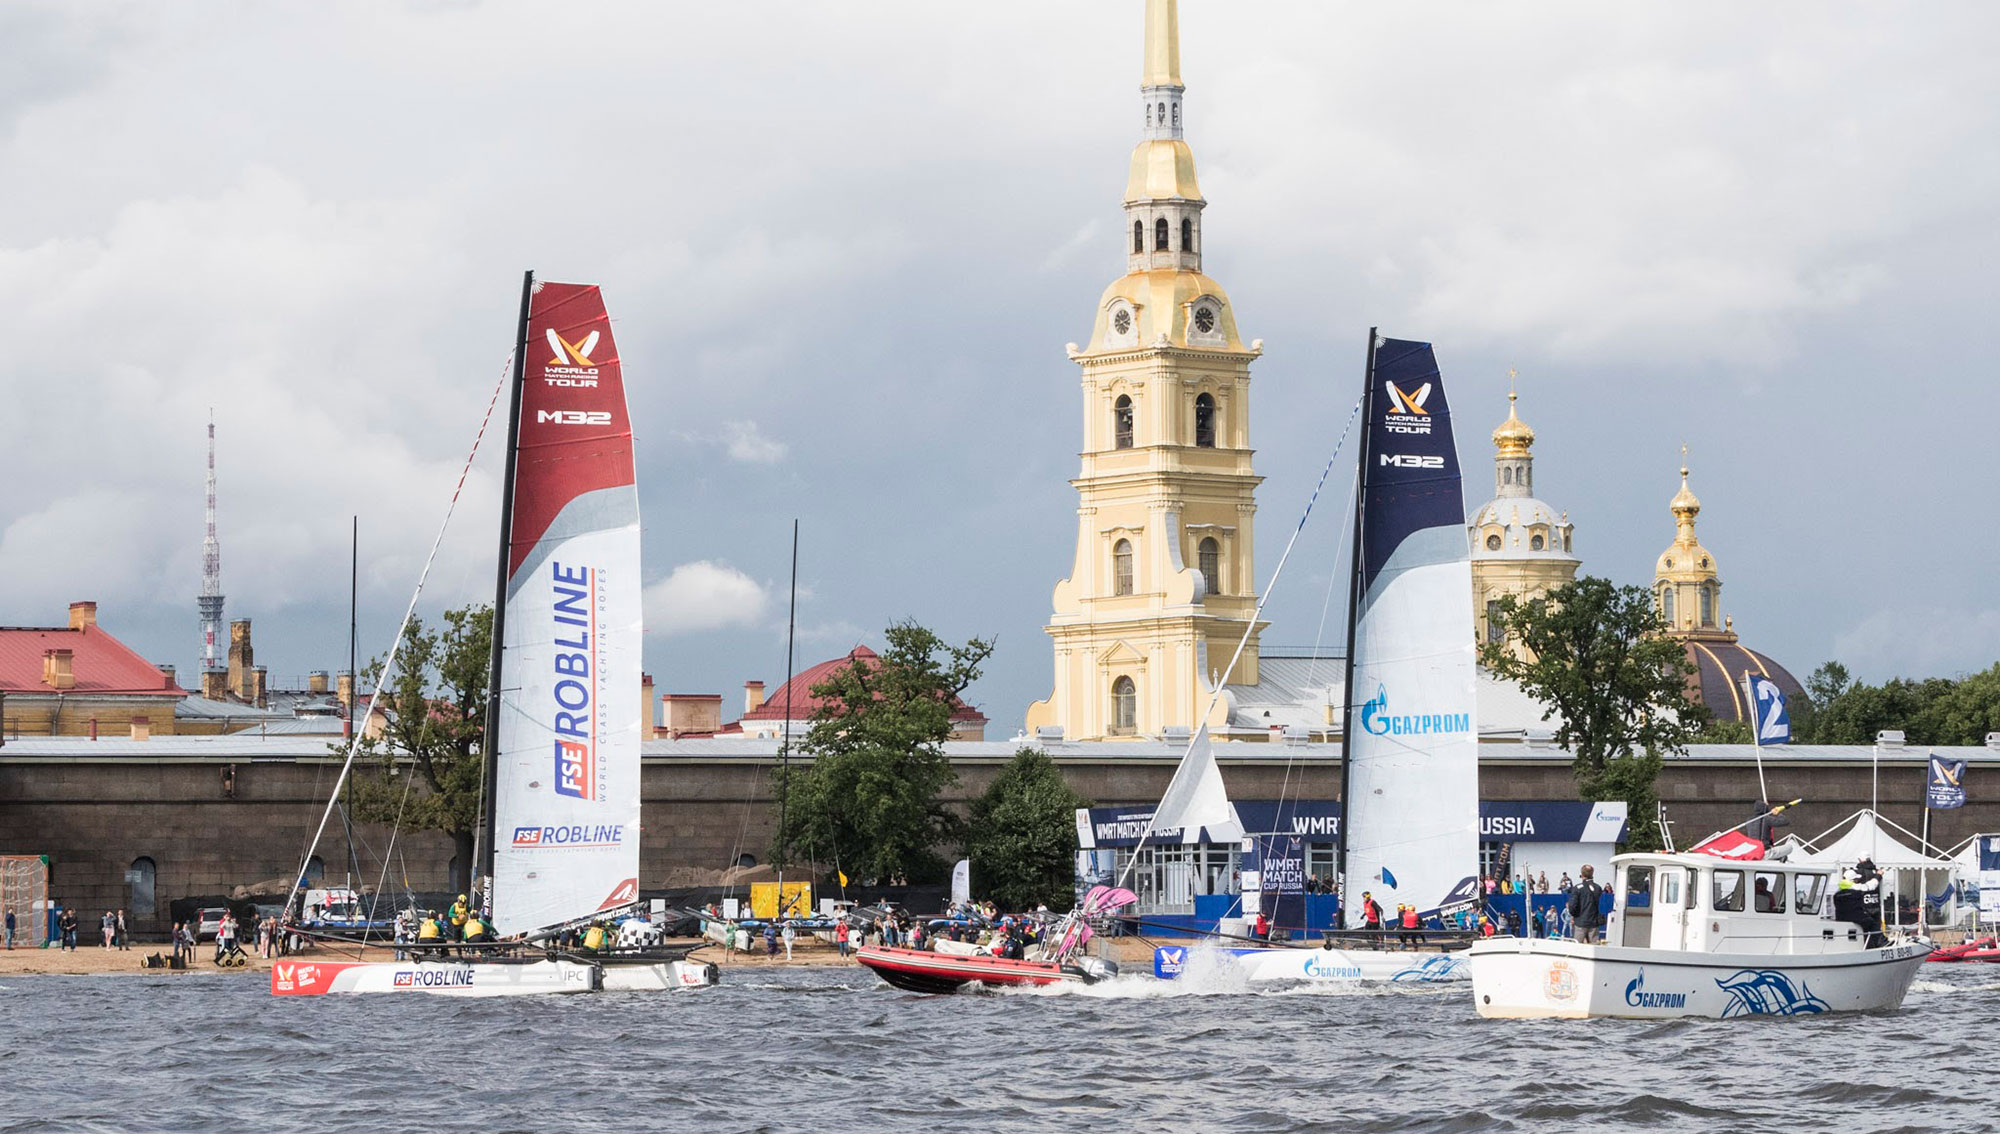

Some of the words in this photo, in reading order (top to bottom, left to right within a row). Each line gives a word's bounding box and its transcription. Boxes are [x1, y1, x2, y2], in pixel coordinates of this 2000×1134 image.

[545, 379, 598, 387] TOUR
[537, 410, 612, 425] M32
[1385, 415, 1432, 423] WORLD
[1385, 426, 1431, 434] TOUR
[1380, 454, 1445, 469] M32
[599, 568, 607, 612] ROPES
[553, 561, 589, 738] ROBLINE
[599, 623, 607, 692] YACHTING
[1757, 680, 1788, 740] 2
[599, 703, 607, 744] CLASS
[1392, 713, 1469, 735] GAZPROM
[562, 747, 582, 791] FSE
[599, 756, 607, 802] WORLD
[1096, 822, 1116, 840] WMRT
[1117, 820, 1140, 838] MATCH
[1292, 816, 1341, 835] WMR
[1479, 816, 1535, 835] USSIA
[516, 830, 539, 841] FSE
[542, 825, 624, 844] ROBLINE
[1263, 858, 1302, 871] WMRT
[1263, 871, 1303, 882] MATCH
[1263, 882, 1278, 890] CUP
[1279, 882, 1304, 890] RUSSIA
[396, 974, 411, 984] FSE
[414, 970, 475, 986] ROBLINE
[563, 970, 583, 981] IPC
[1321, 967, 1361, 977] GAZPROM
[1642, 992, 1686, 1008] GAZPROM
